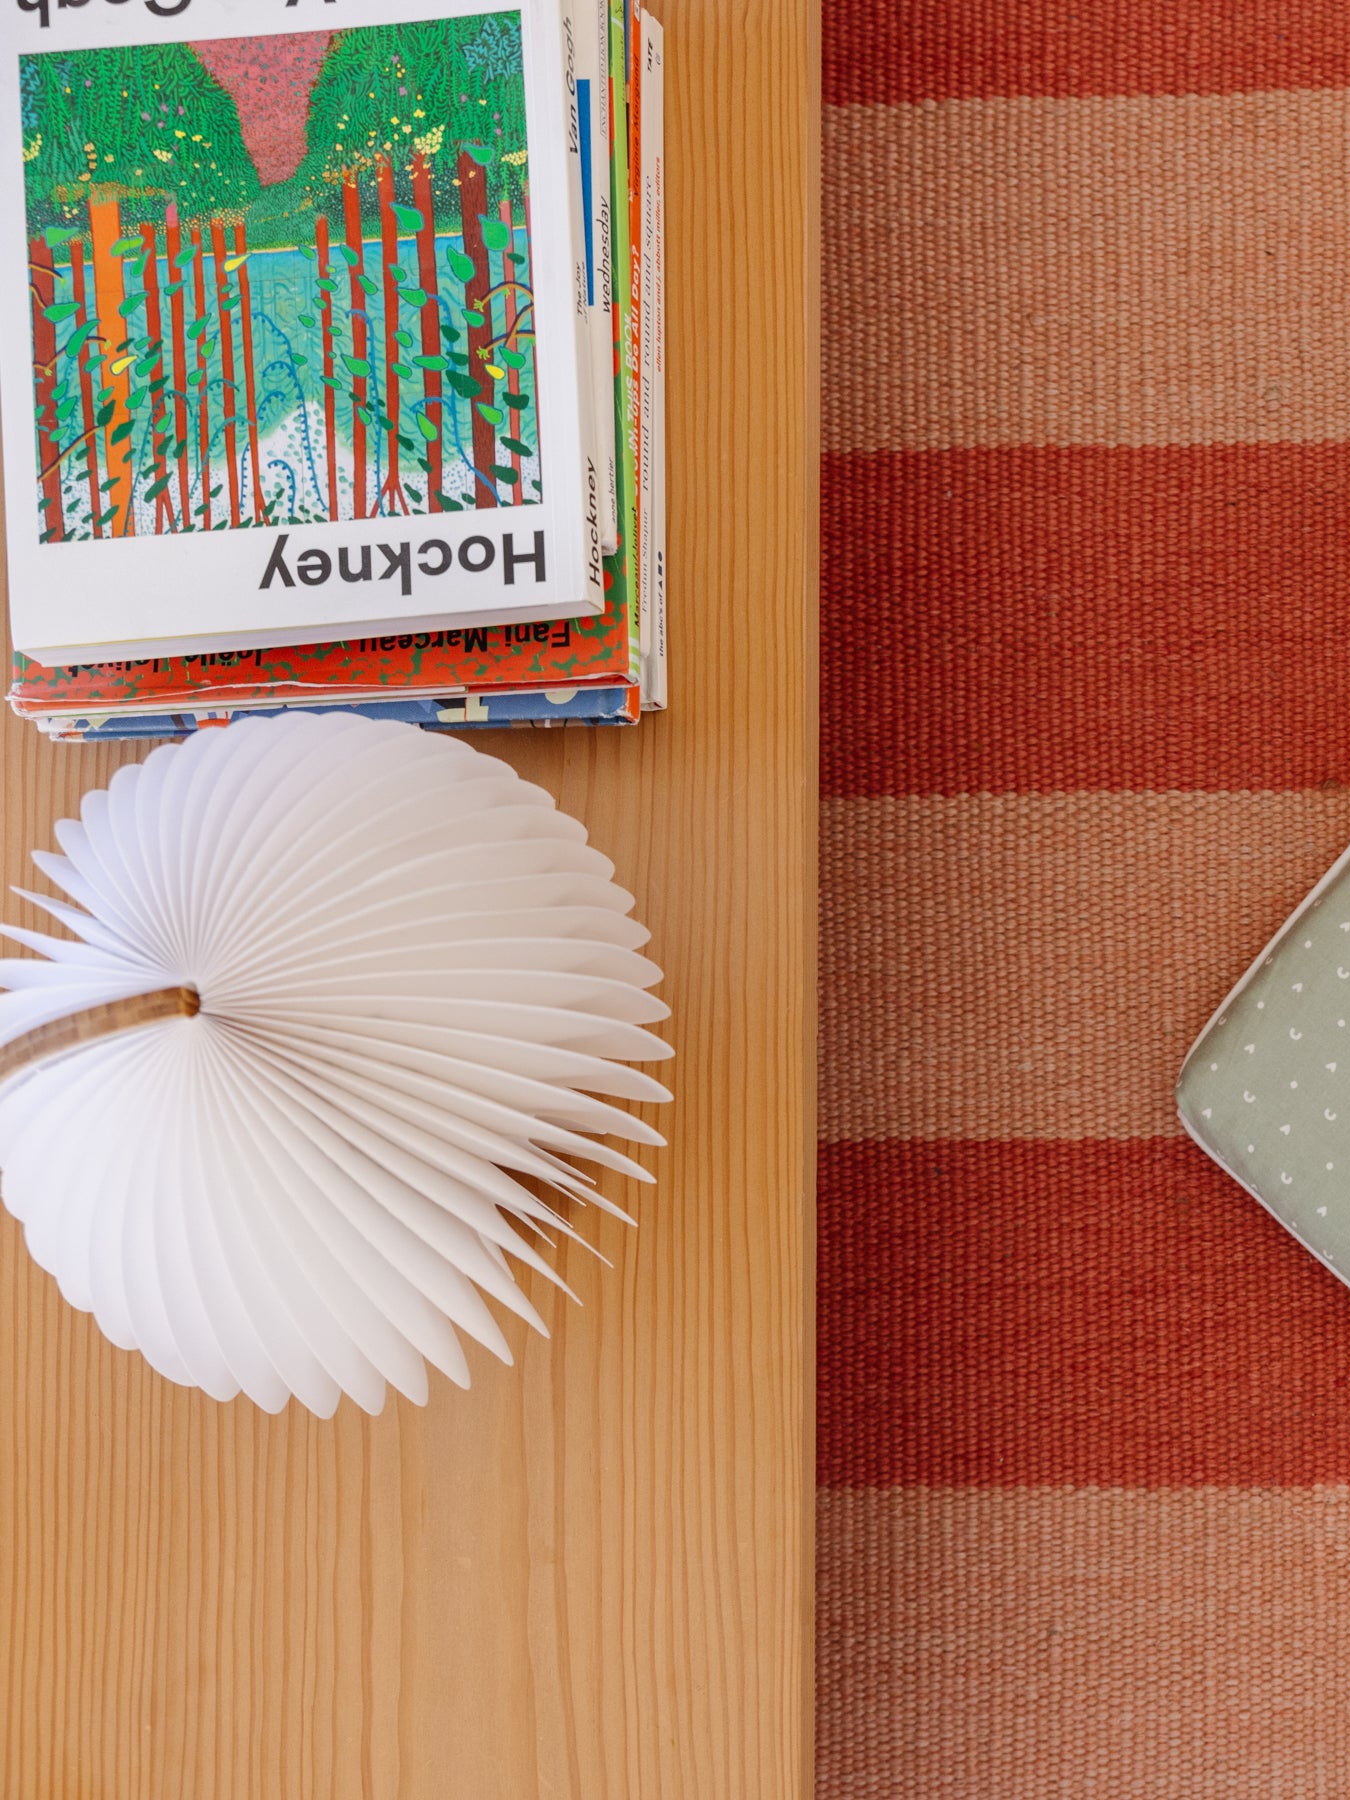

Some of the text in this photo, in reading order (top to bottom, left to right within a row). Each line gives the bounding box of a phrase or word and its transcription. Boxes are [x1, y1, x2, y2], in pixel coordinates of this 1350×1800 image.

[563, 16, 579, 154] Van Gogh
[645, 175, 653, 250] square
[596, 195, 611, 313] wednesday
[631, 244, 641, 301] Day?
[643, 252, 651, 296] and
[631, 305, 639, 338] All
[624, 311, 636, 452] IN THIS BOOK
[631, 342, 639, 373] Do
[642, 375, 650, 419] and
[586, 456, 601, 587] Hockney
[258, 530, 546, 596] Hockney
[359, 621, 570, 653] Fani Marceau
